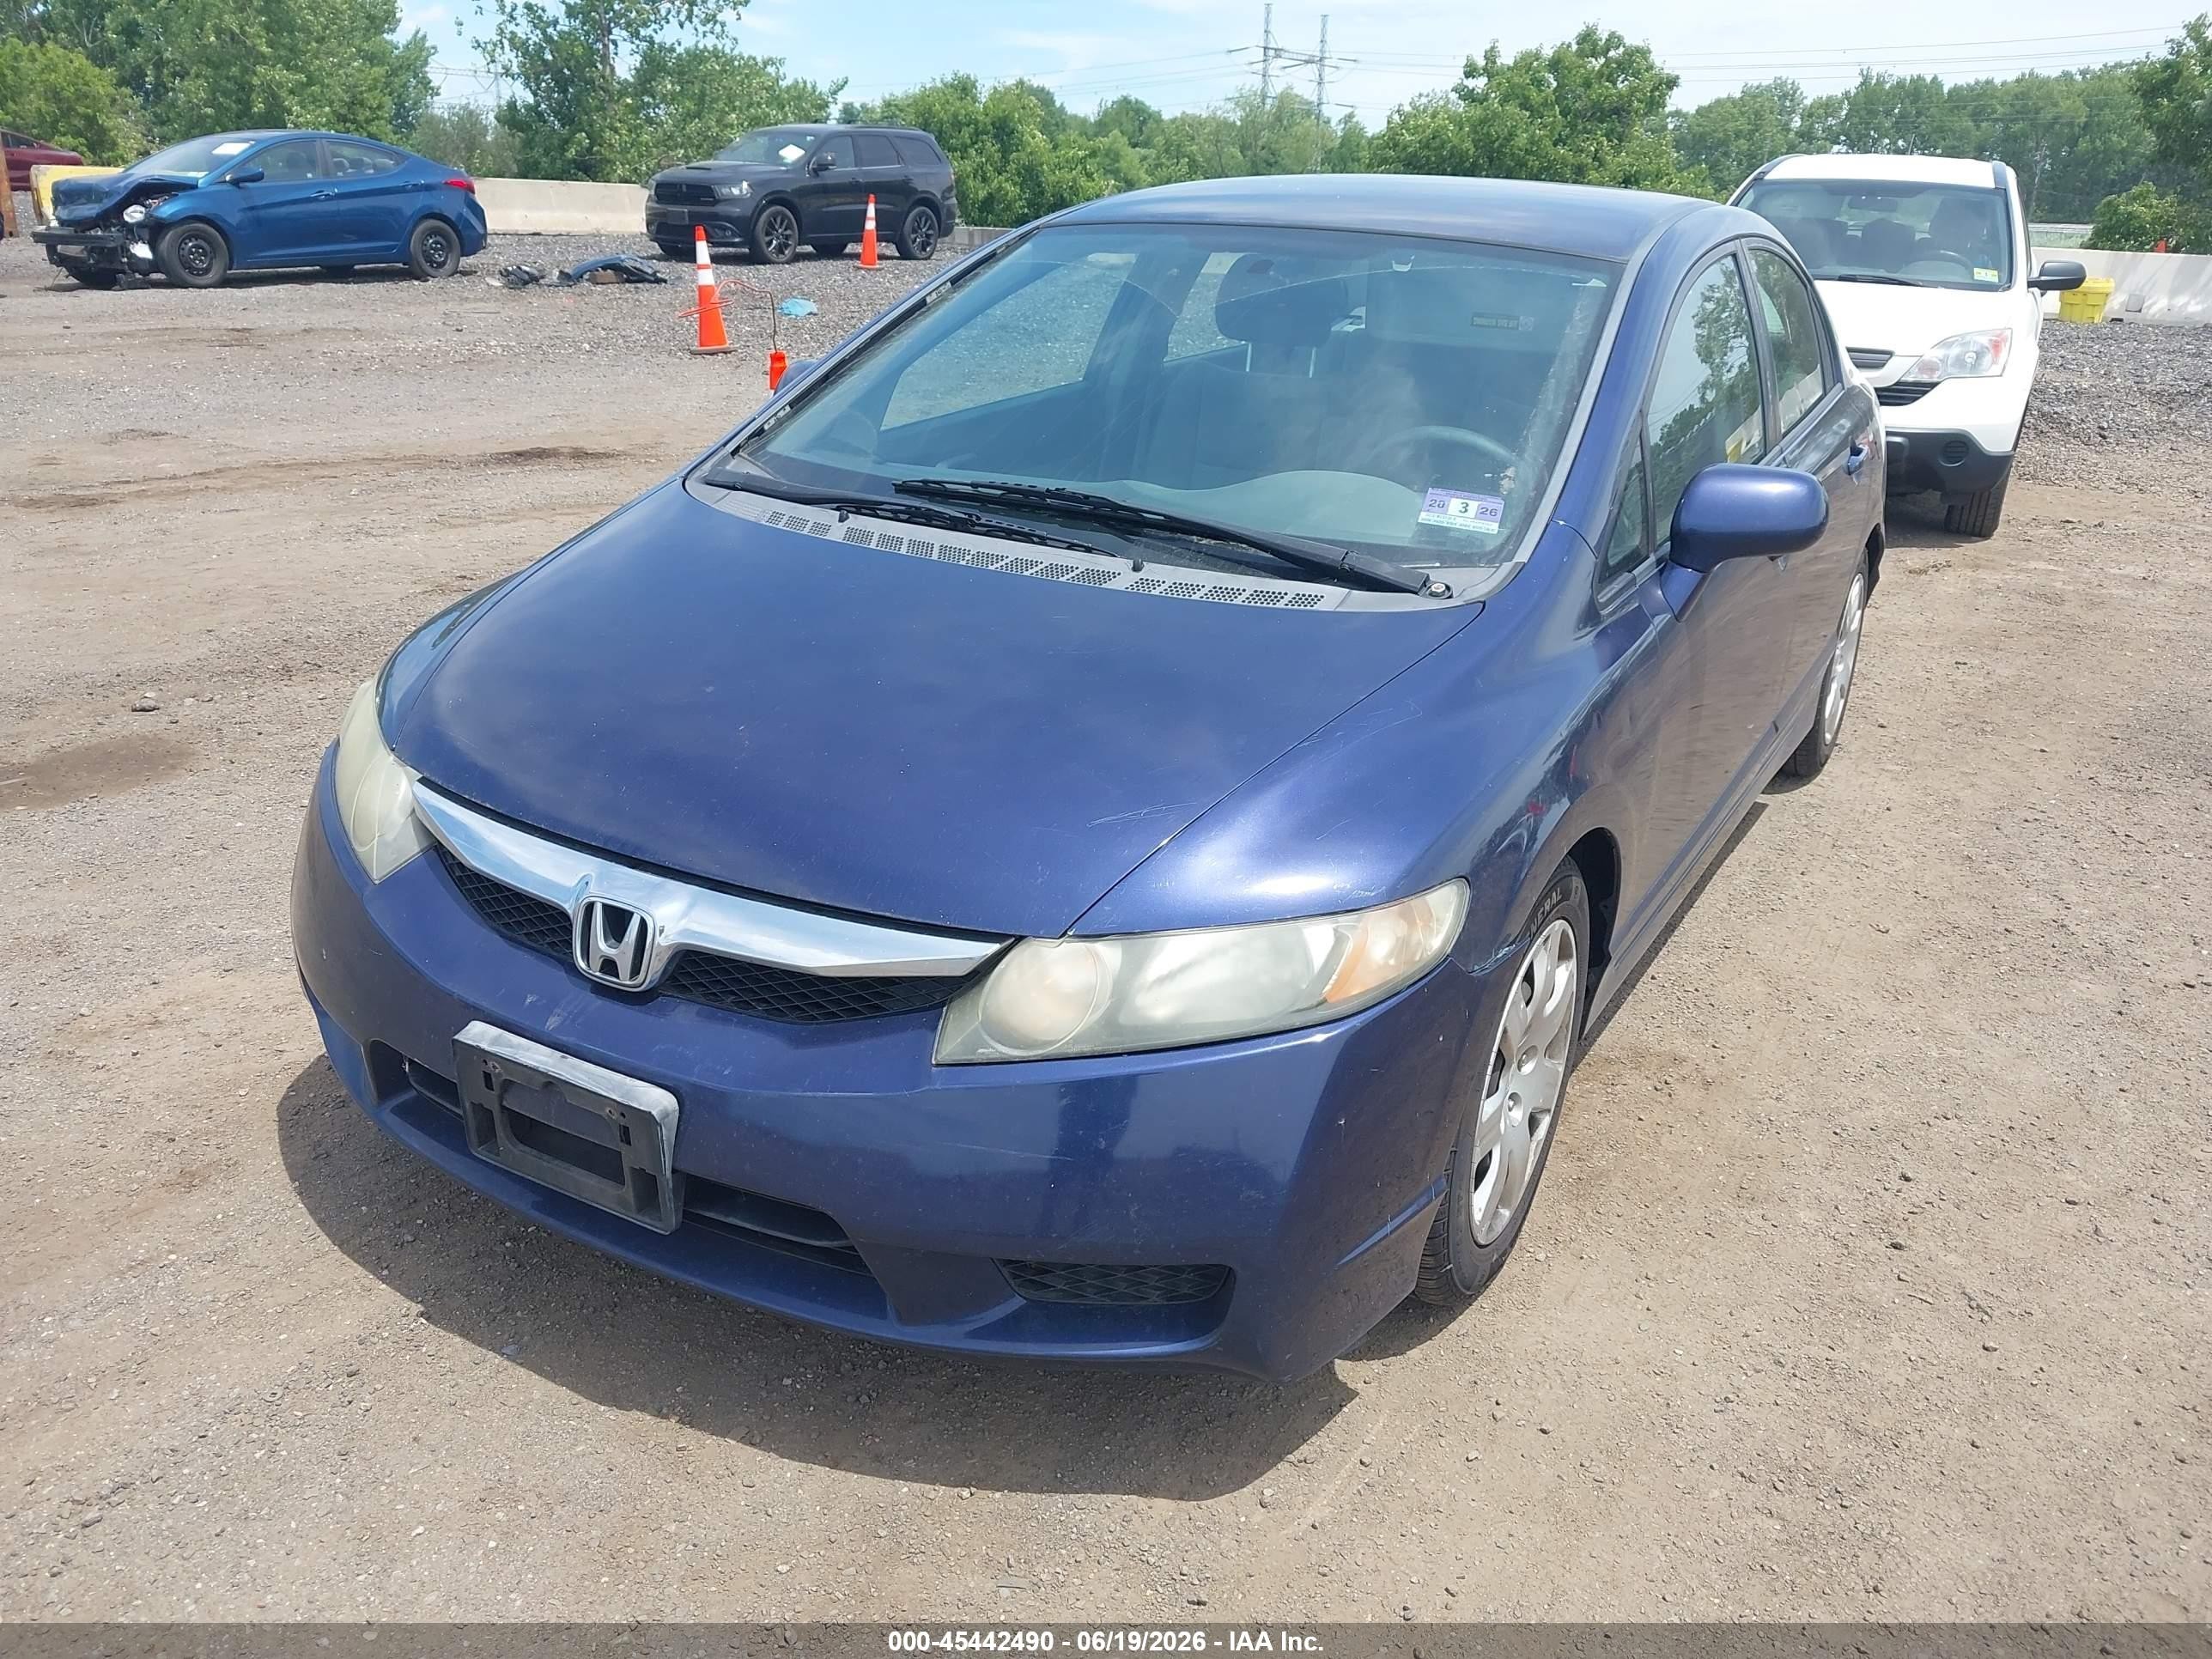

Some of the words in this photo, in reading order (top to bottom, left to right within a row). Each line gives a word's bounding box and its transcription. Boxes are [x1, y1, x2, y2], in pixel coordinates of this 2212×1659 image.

[1458, 501, 1469, 514] 3
[1479, 507, 1498, 517] 26
[1528, 886, 1563, 941] NERAL
